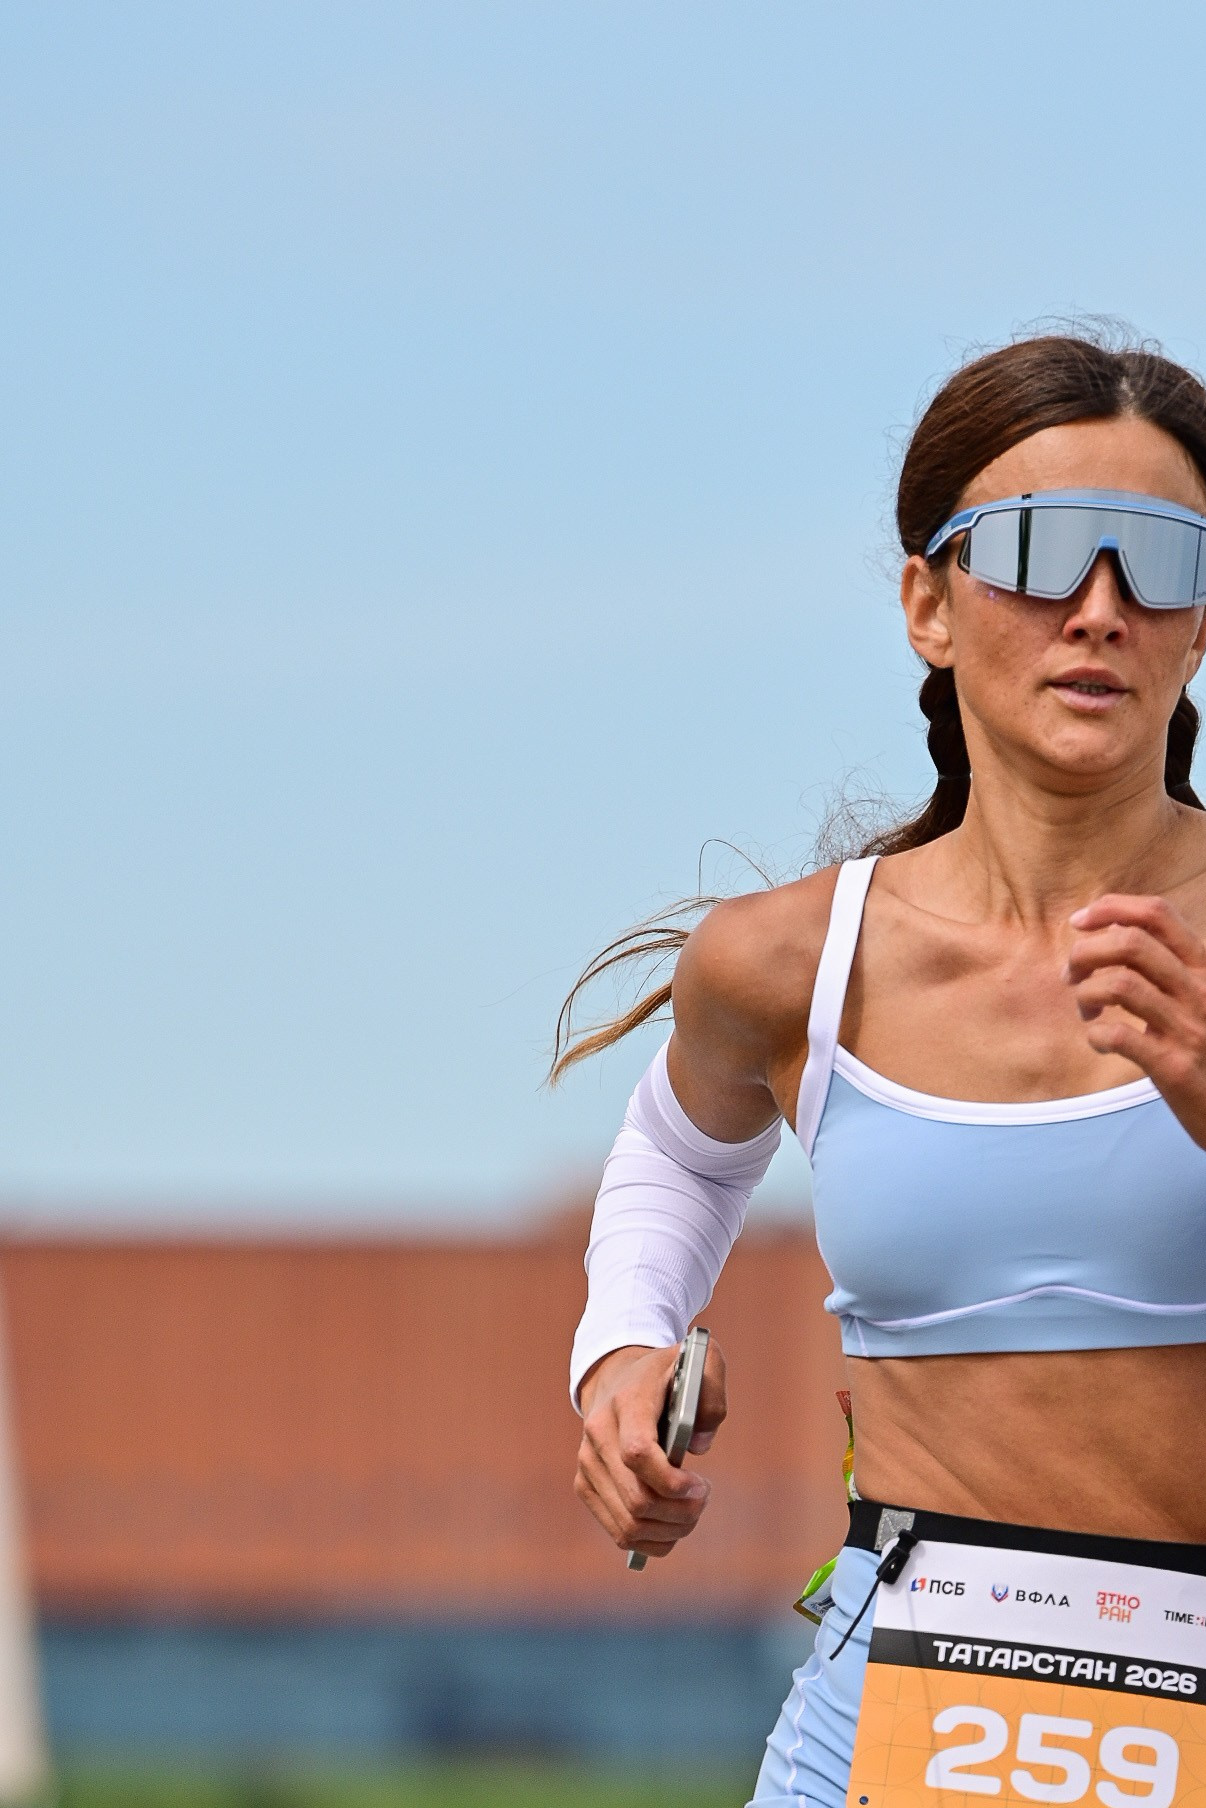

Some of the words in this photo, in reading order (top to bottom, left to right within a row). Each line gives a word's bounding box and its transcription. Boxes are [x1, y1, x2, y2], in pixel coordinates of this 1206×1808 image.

[929, 1579, 966, 1596] ПСБ
[1015, 1589, 1070, 1607] ВФЛА
[1096, 1591, 1140, 1609] ЭТНО
[933, 1640, 1117, 1683] ТАТАРСТАН
[1124, 1664, 1198, 1695] 2026
